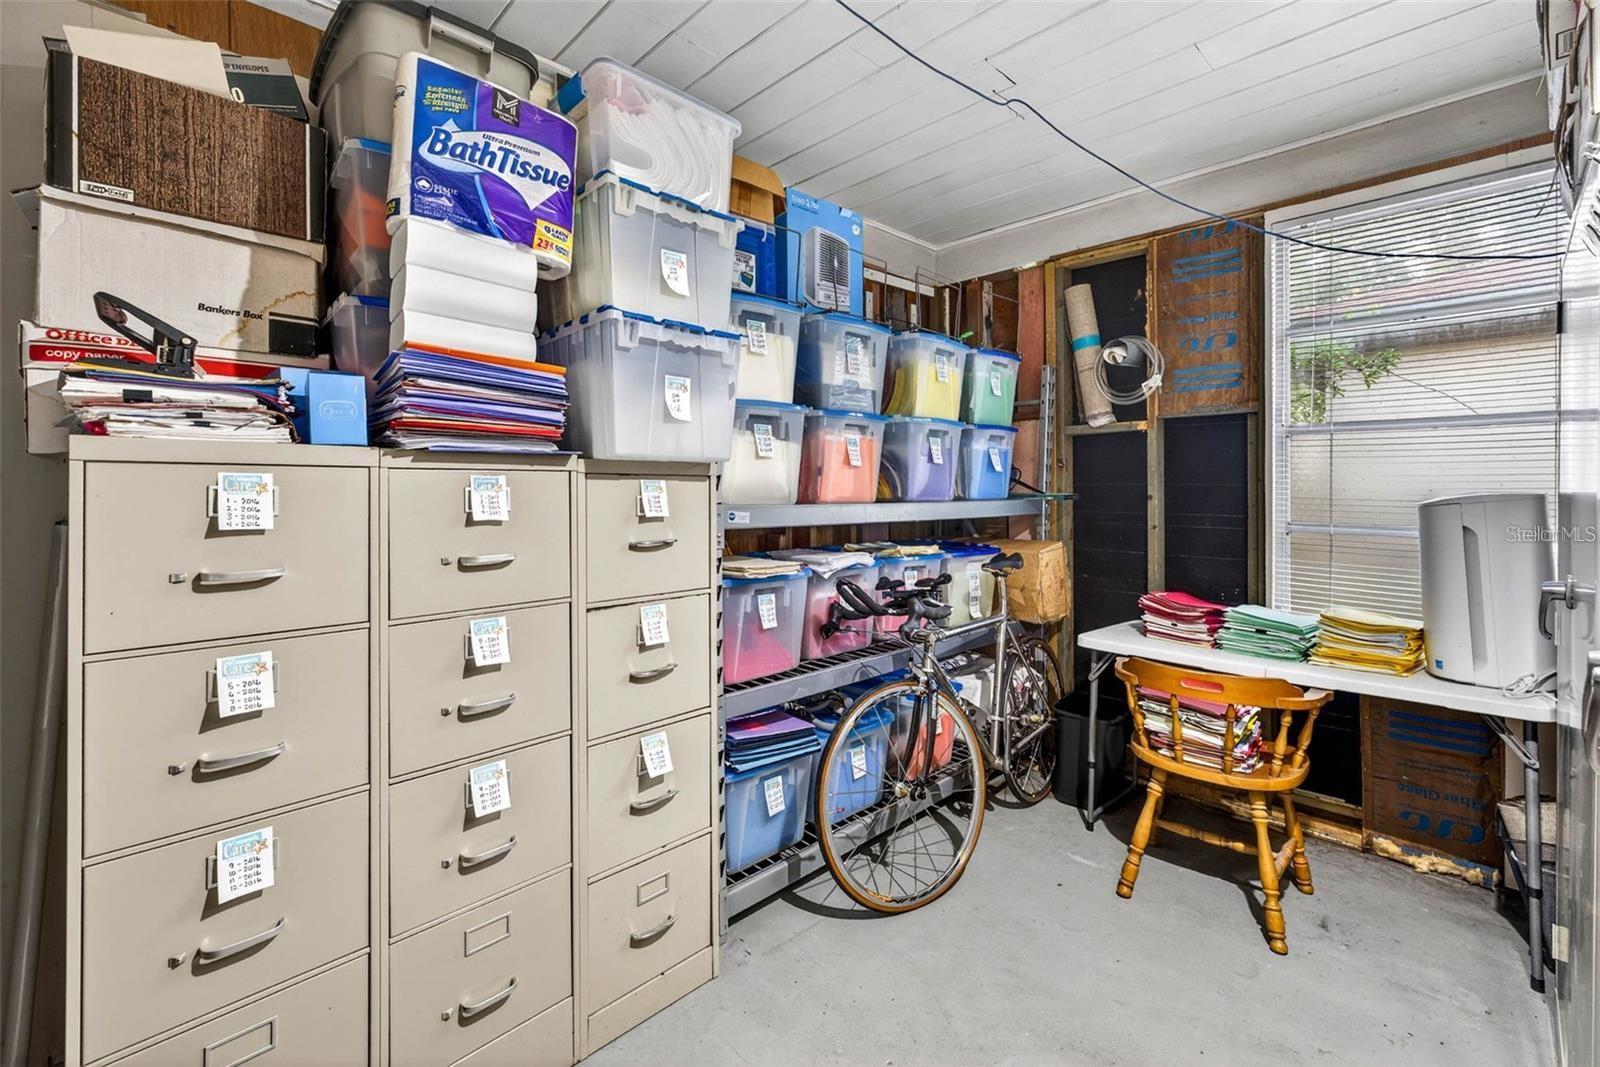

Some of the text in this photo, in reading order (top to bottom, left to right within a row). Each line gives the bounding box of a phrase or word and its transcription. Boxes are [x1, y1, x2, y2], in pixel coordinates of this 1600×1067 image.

[482, 133, 541, 157] Ultra Premium
[197, 302, 263, 320] Bankers Box
[45, 328, 113, 345] Office
[45, 350, 81, 359] copy
